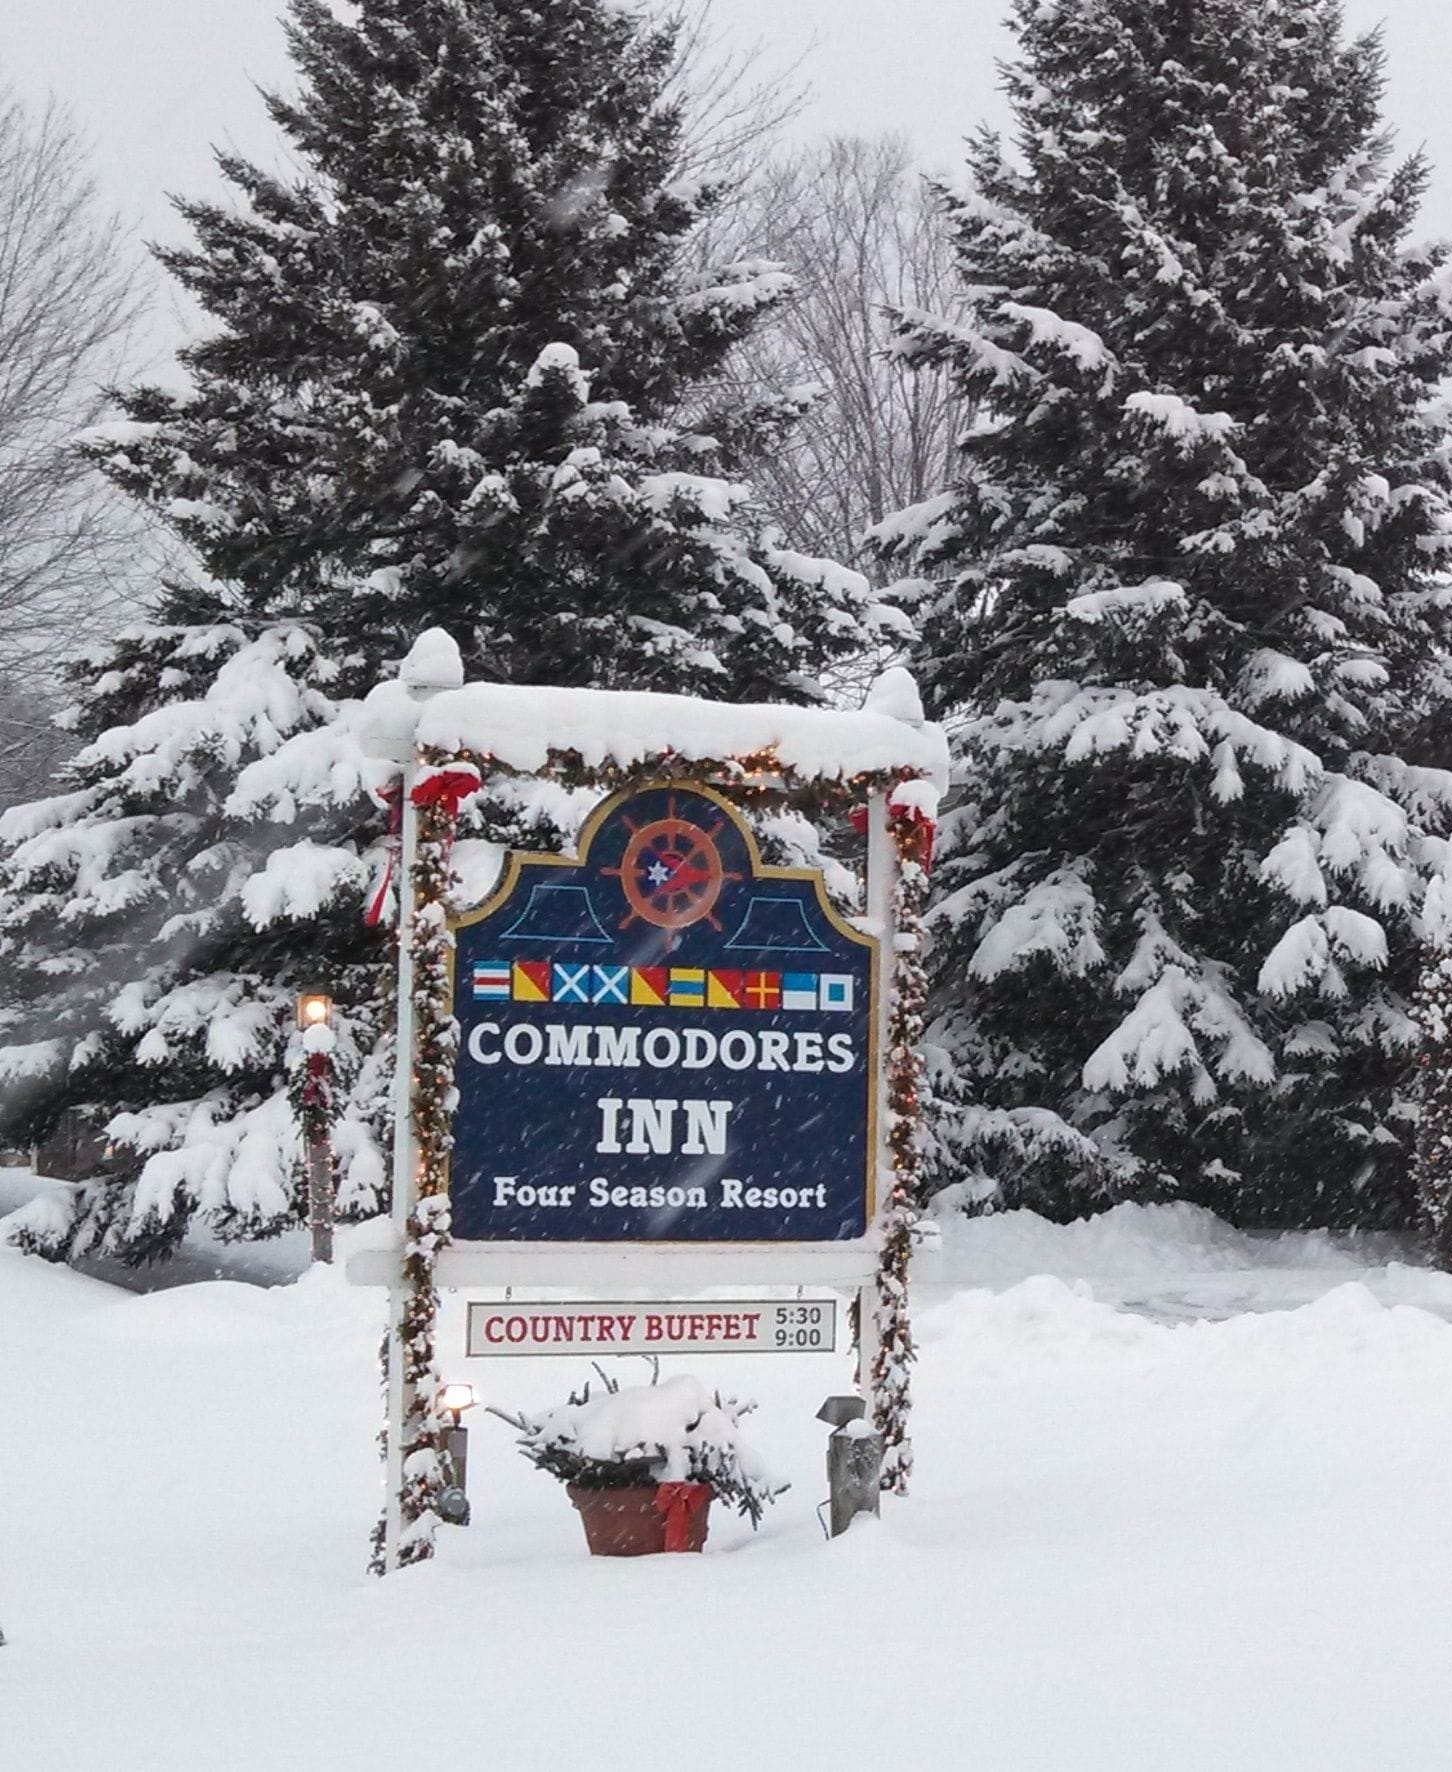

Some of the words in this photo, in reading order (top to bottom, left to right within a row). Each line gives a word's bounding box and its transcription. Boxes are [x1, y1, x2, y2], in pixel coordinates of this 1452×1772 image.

[467, 1022, 856, 1074] COMMODORES
[596, 1097, 733, 1155] INN
[492, 1176, 576, 1208] Four
[589, 1177, 708, 1209] Season
[720, 1178, 827, 1208] Resort
[484, 1314, 636, 1344] COUNTRY
[644, 1313, 761, 1342] BUFFET
[775, 1307, 821, 1325] 5:30
[774, 1328, 821, 1346] 9:00
